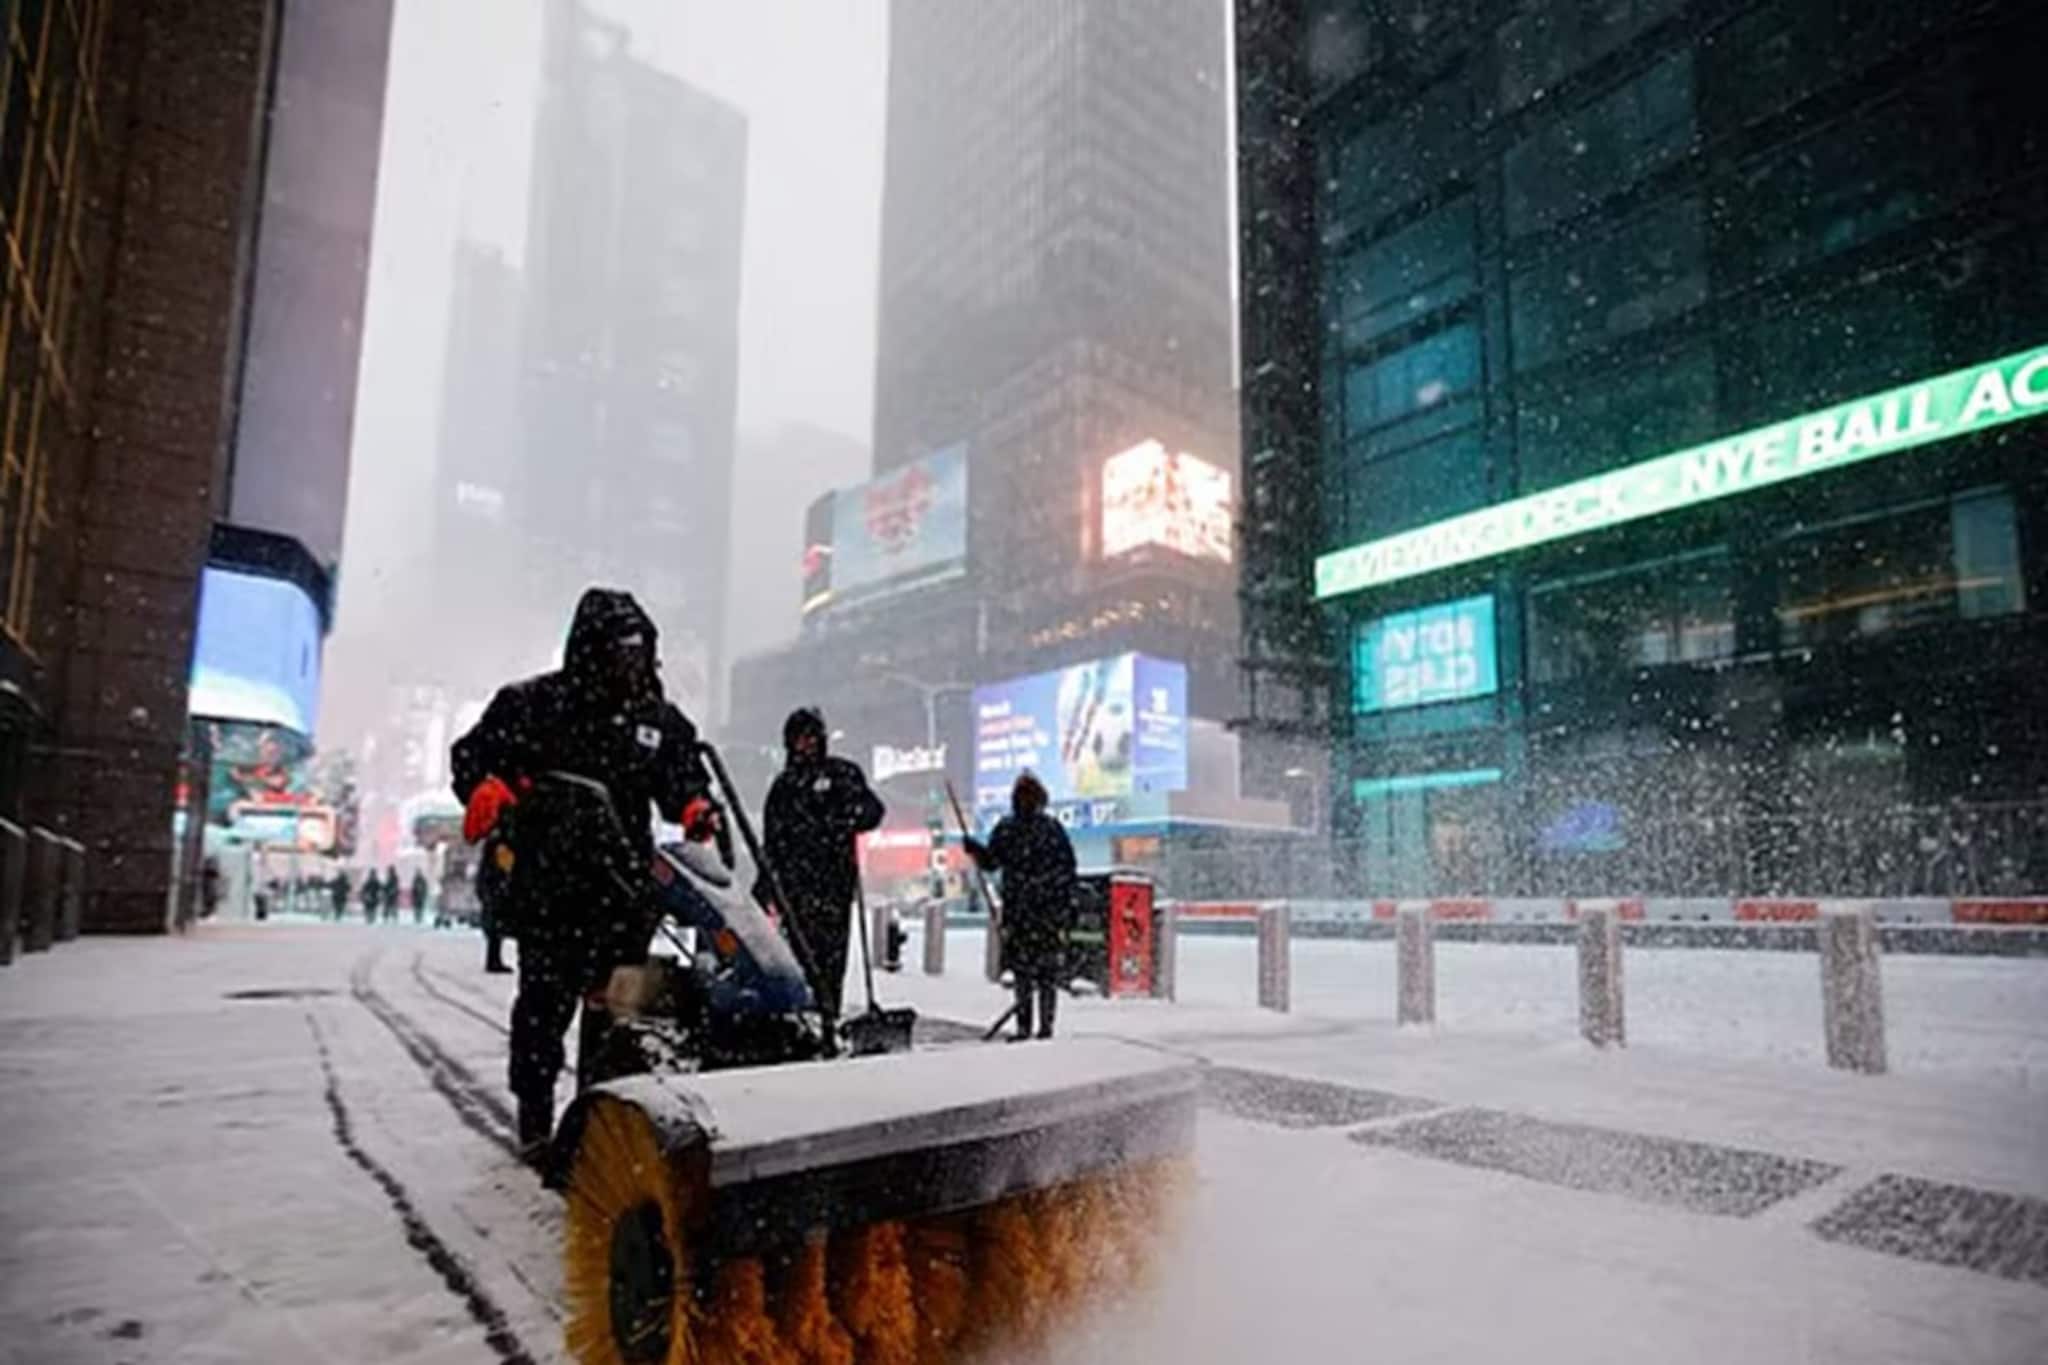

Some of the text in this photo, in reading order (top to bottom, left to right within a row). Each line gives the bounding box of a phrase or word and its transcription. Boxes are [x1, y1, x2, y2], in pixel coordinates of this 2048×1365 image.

[1515, 477, 1624, 539] DECK
[1679, 430, 1784, 496] NYE
[1798, 389, 1939, 467] BALL
